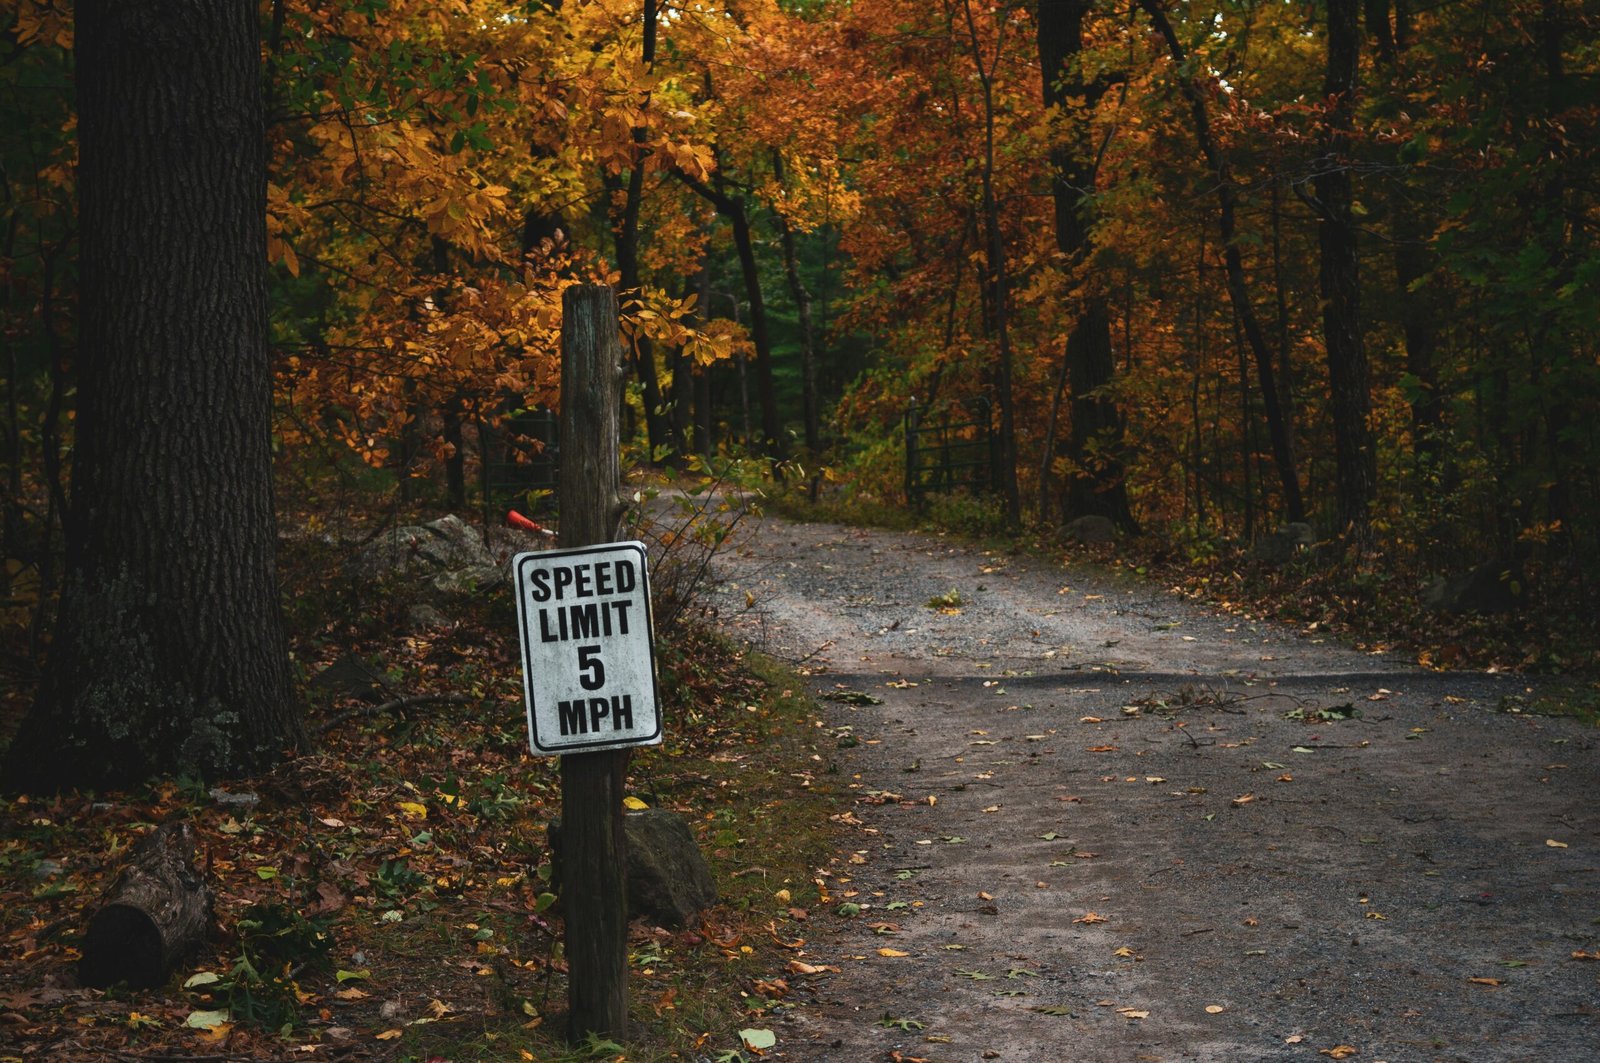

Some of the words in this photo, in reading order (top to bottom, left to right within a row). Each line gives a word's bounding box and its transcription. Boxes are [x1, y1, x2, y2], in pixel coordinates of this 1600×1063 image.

[531, 560, 636, 602] SPEED
[539, 600, 632, 643] LIMIT
[578, 645, 605, 691] 5
[558, 695, 633, 736] MPH
